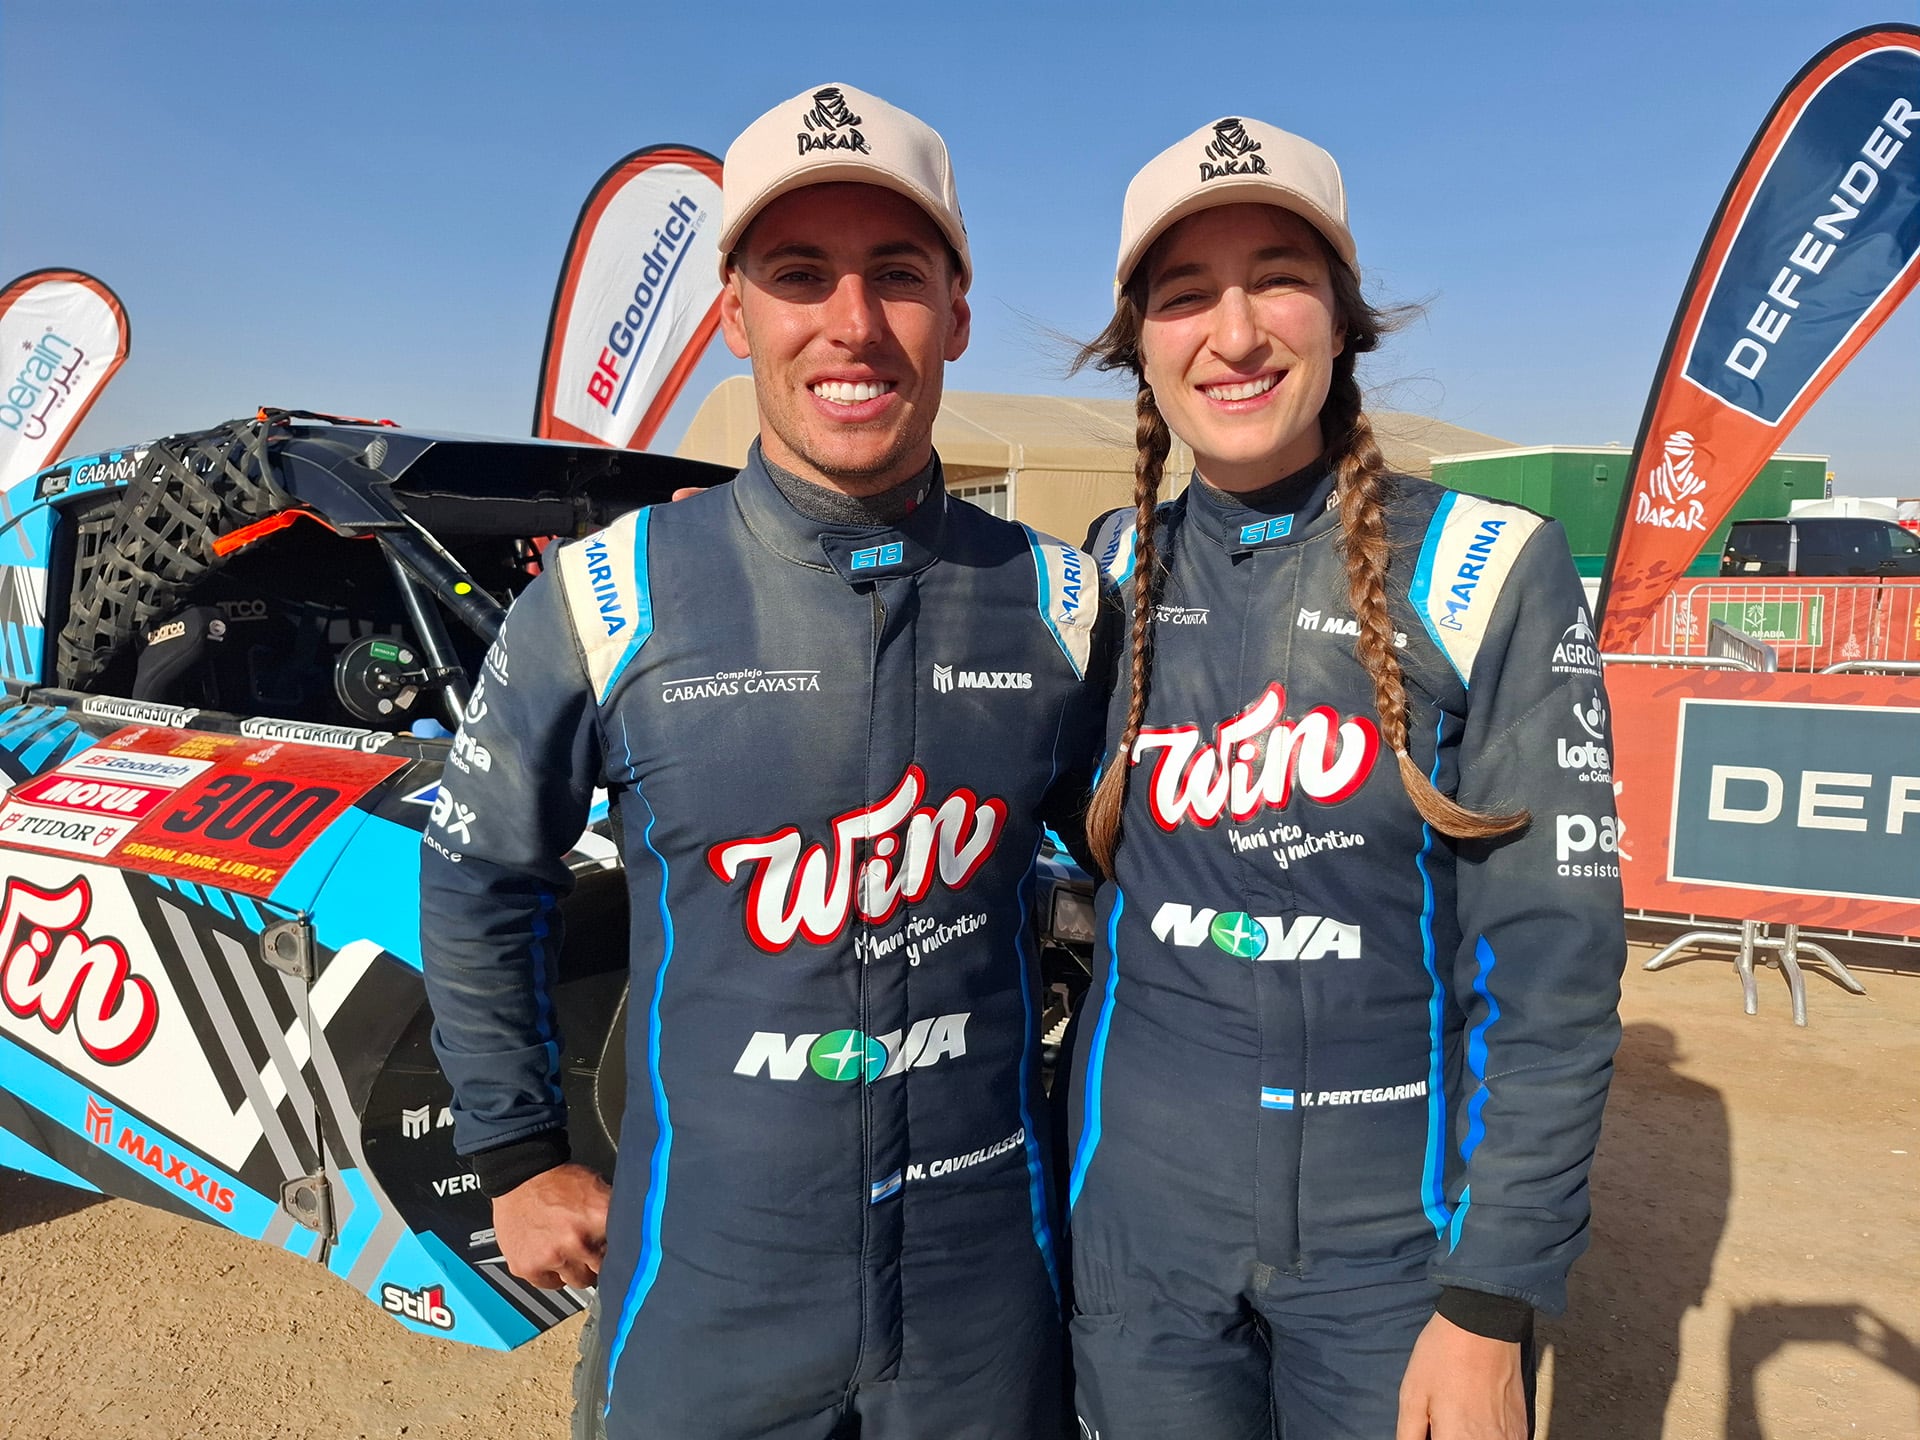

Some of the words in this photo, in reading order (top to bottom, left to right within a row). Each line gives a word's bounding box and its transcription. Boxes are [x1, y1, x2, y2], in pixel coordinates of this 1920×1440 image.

[798, 128, 869, 155] DAKAR
[1200, 154, 1269, 182] DAKAR
[1725, 97, 1920, 380] DEFENDER
[587, 195, 698, 408] BFGoodrich
[1239, 514, 1294, 545] 68
[1635, 492, 1706, 531] DAKAR
[850, 541, 904, 571] 68
[1439, 519, 1507, 631] MARINA
[584, 531, 626, 637] MARINA
[662, 681, 740, 703] CABAÑAS
[744, 674, 821, 695] CAYASTÁ
[715, 668, 763, 683] Complejo
[957, 671, 1033, 689] MAXXIS
[84, 754, 190, 776] BFGoodrich
[1130, 681, 1380, 833] Win
[1557, 737, 1611, 770] lote
[36, 779, 150, 812] MOTUL
[1578, 772, 1590, 782] de
[17, 815, 97, 845] TUDOR
[162, 773, 342, 851] 300
[1268, 822, 1303, 844] rico
[1272, 848, 1289, 870] y
[1287, 830, 1365, 861] nutritivo
[1556, 814, 1619, 861] pa
[121, 842, 177, 862] DREAM.
[175, 852, 221, 871] DARE.
[218, 860, 258, 878] LIVE
[253, 867, 277, 883] IT.
[707, 763, 1008, 954] Win
[1557, 862, 1620, 878] assista
[906, 916, 935, 939] rico
[906, 943, 921, 967] y
[921, 912, 988, 954] nutritivo
[1150, 902, 1361, 961] NOVA
[733, 1012, 971, 1086] NOVA
[1317, 1080, 1428, 1107] PERTEGARINI
[118, 1128, 235, 1215] MAXXIS
[905, 1163, 927, 1182] N.
[929, 1127, 1026, 1179] CAVIGLIASSO
[382, 1285, 453, 1328] Stilo
